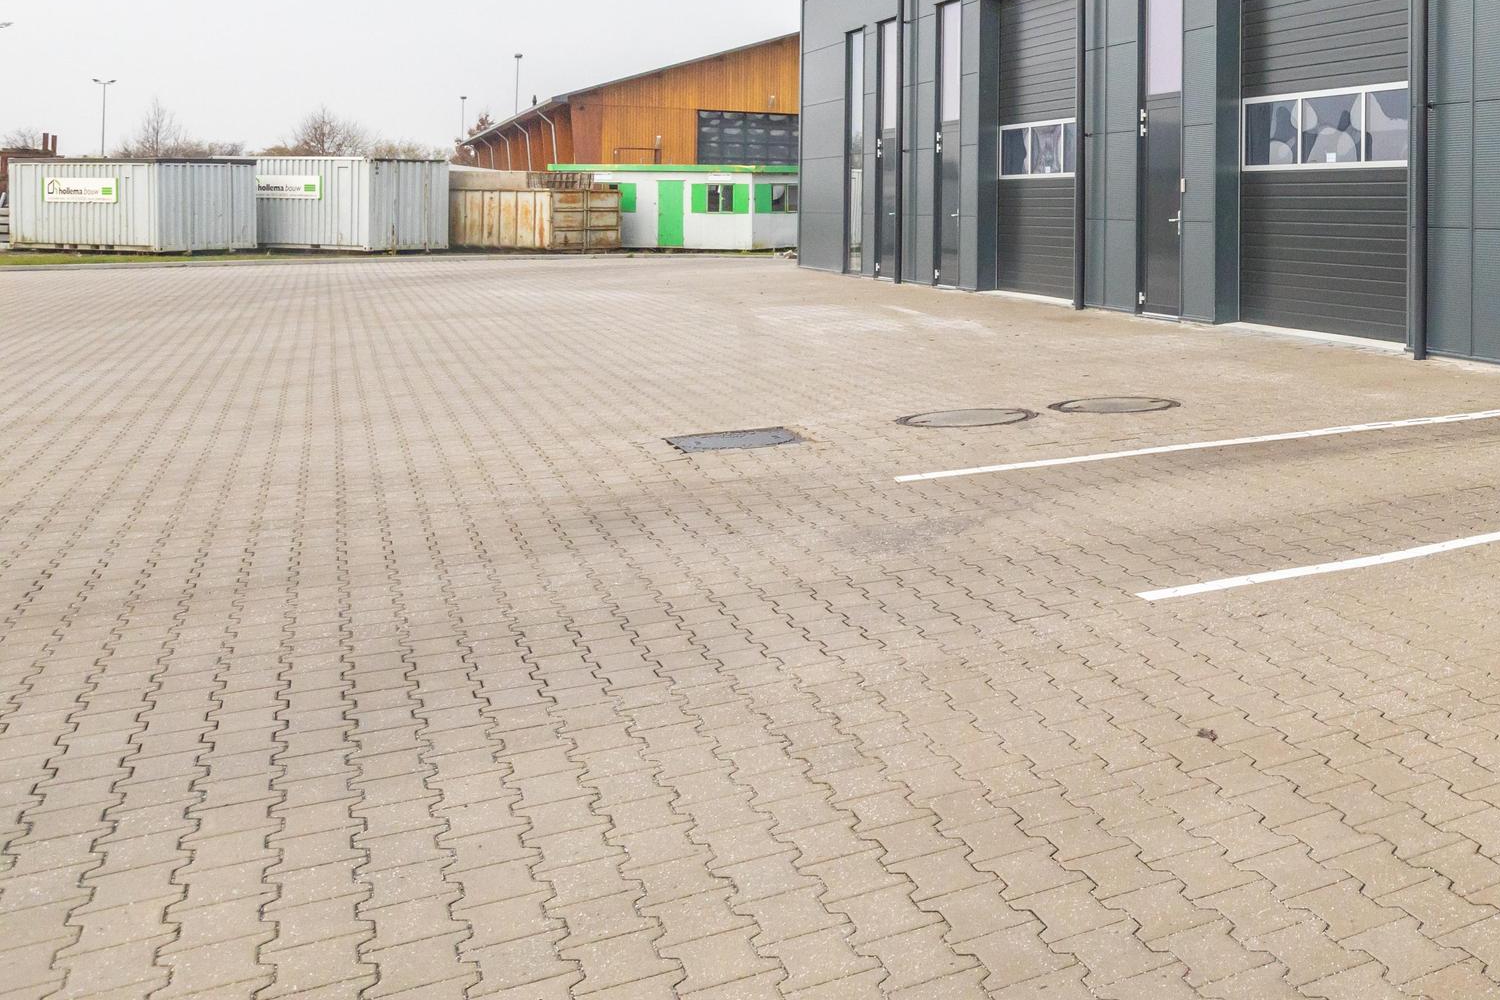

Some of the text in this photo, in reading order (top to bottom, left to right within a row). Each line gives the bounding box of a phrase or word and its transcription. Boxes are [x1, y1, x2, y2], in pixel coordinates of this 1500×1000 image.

[58, 186, 83, 195] hollema
[257, 184, 302, 192] hollema bouw
